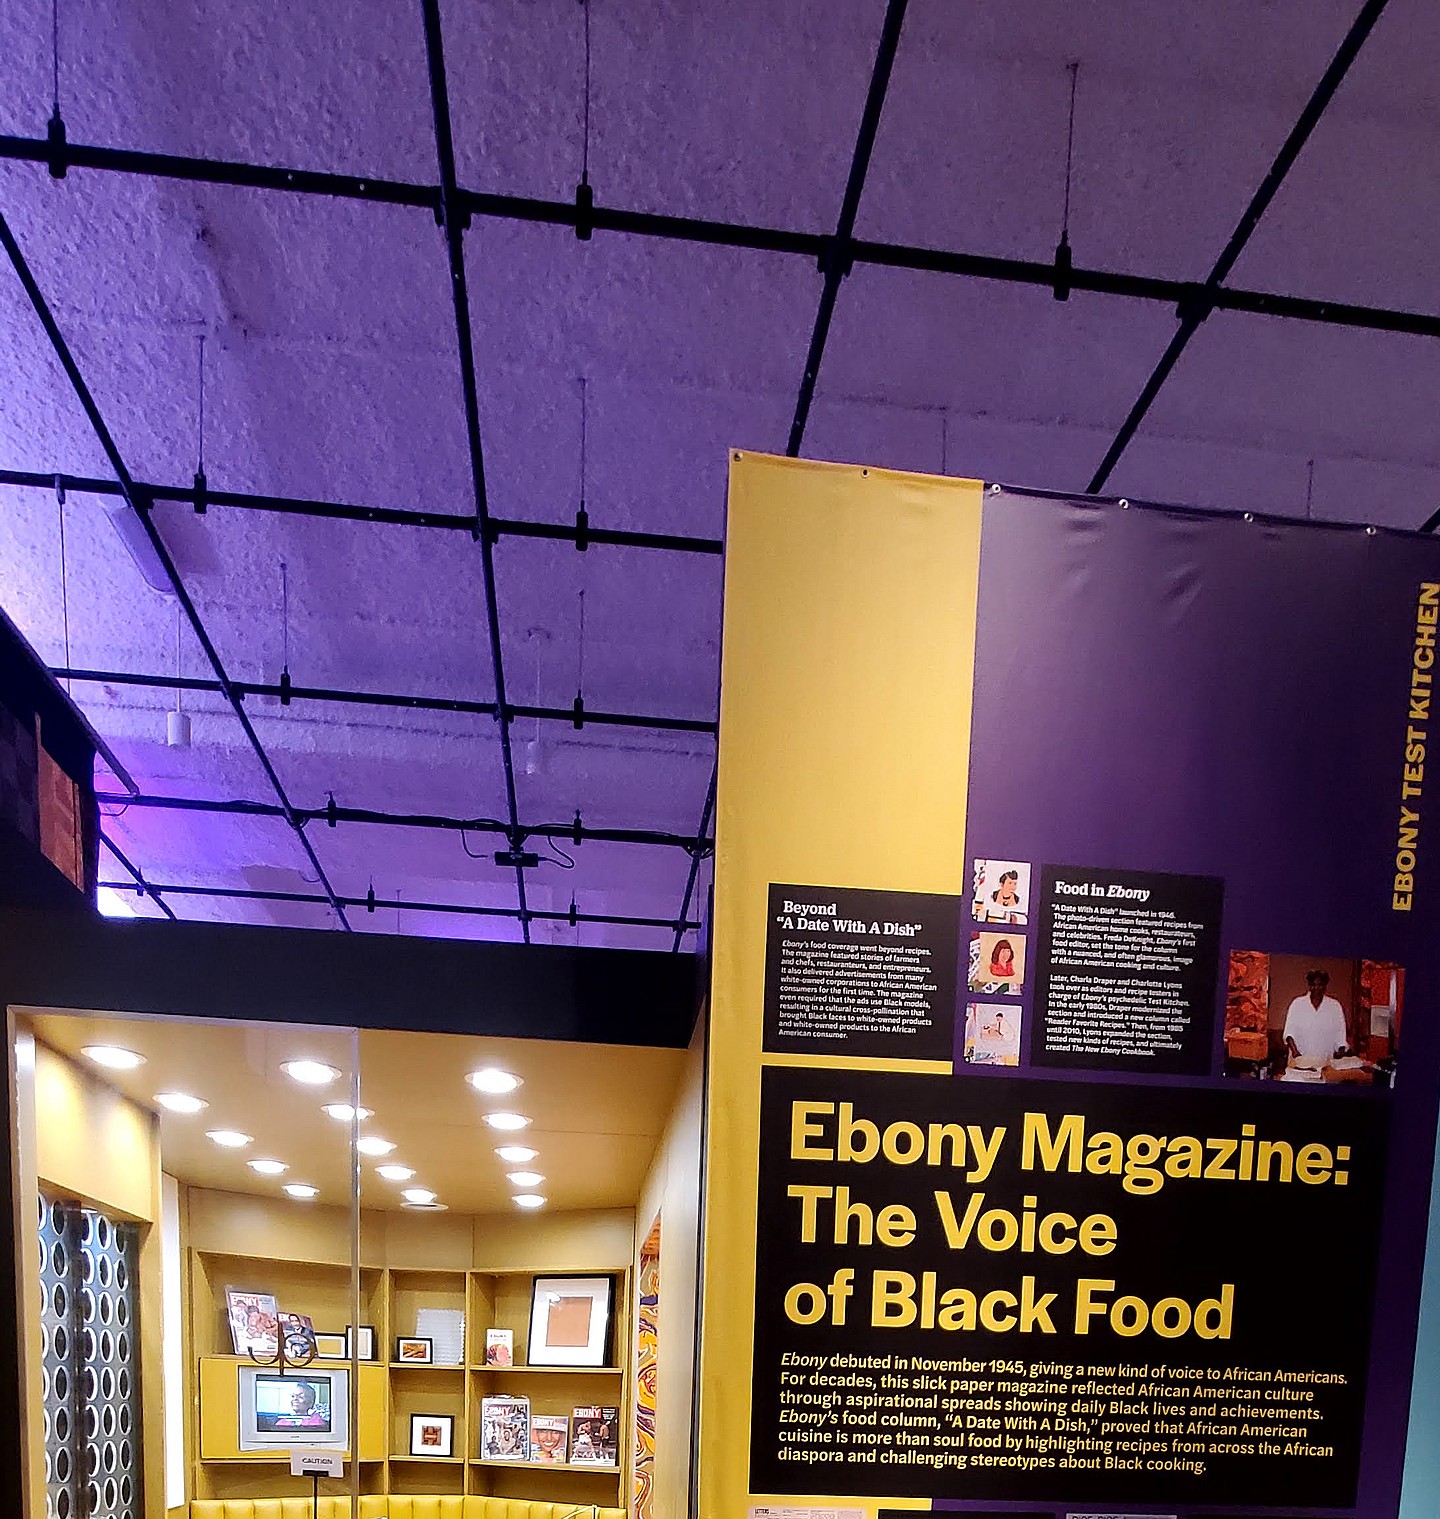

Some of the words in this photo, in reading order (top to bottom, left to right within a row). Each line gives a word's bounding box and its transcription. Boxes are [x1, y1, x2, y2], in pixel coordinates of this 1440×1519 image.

[1408, 582, 1440, 720] KITCHEN
[1402, 725, 1427, 800] TEST
[1392, 806, 1420, 911] EBONY
[1054, 881, 1089, 896] Food
[1090, 883, 1105, 897] in
[1105, 884, 1150, 902] Ebony
[782, 900, 837, 917] Beyond
[776, 916, 794, 929] "A
[796, 917, 830, 931] Date
[831, 919, 867, 933] With
[868, 921, 881, 934] A
[882, 922, 922, 937] Dish"
[790, 1100, 1007, 1183] Ebony
[1021, 1111, 1351, 1195] Magazine:
[787, 1184, 917, 1247] The
[934, 1190, 1118, 1256] Voice
[783, 1268, 855, 1326] of
[871, 1269, 1058, 1334] Black
[1074, 1278, 1235, 1339] Food
[780, 1351, 828, 1370] Ebony
[829, 1352, 891, 1369] debuted
[894, 1355, 908, 1370] in
[911, 1356, 987, 1372] November
[988, 1359, 1027, 1377] 1945,
[1029, 1360, 1074, 1380] giving
[1075, 1365, 1084, 1376] a
[1087, 1365, 1116, 1377] new
[1118, 1363, 1148, 1378] kind
[1150, 1364, 1167, 1378] of
[1167, 1365, 1204, 1379] voice
[1206, 1367, 1221, 1380] to
[1222, 1366, 1271, 1381] African
[1273, 1369, 1347, 1384] Americans.
[780, 1371, 806, 1385] For
[809, 1371, 876, 1391] decades,
[880, 1373, 909, 1389] this
[912, 1374, 947, 1390] slick
[950, 1379, 995, 1395] paper
[997, 1379, 1068, 1397] magazine
[1071, 1380, 1135, 1396] reflected
[1137, 1382, 1190, 1397] African
[1192, 1385, 1261, 1399] American
[1264, 1386, 1314, 1401] culture
[779, 1389, 841, 1409] through
[845, 1392, 938, 1410] aspirational
[941, 1395, 1001, 1413] spreads
[1004, 1396, 1068, 1416] showing
[1071, 1398, 1106, 1417] daily
[1109, 1400, 1149, 1415] Black
[1153, 1401, 1186, 1416] lives
[1189, 1403, 1216, 1416] and
[1220, 1403, 1323, 1420] achievements.
[779, 1408, 839, 1427] Ebony's
[841, 1409, 877, 1425] food
[880, 1411, 941, 1430] column,
[945, 1413, 963, 1428] "A
[966, 1415, 1001, 1429] Date
[1003, 1415, 1037, 1430] With
[1039, 1417, 1051, 1431] A
[1054, 1417, 1098, 1435] Dish,"
[1101, 1419, 1150, 1435] proved
[1154, 1420, 1184, 1434] that
[1186, 1420, 1237, 1435] African
[1239, 1423, 1307, 1438] American
[778, 1428, 832, 1443] cuisine
[836, 1429, 848, 1443] is
[852, 1433, 892, 1445] more
[895, 1430, 930, 1446] than
[933, 1432, 964, 1447] soul
[967, 1432, 1002, 1448] food
[1005, 1433, 1023, 1452] by
[1025, 1434, 1113, 1455] highlighting
[1116, 1438, 1168, 1455] recipes
[1171, 1438, 1205, 1453] from
[1208, 1443, 1254, 1454] across
[1258, 1441, 1281, 1455] the
[1283, 1441, 1333, 1456] African
[777, 1446, 844, 1465] diaspora
[847, 1448, 876, 1463] and
[879, 1449, 968, 1470] challenging
[970, 1453, 1056, 1471] stereotypes
[1058, 1454, 1101, 1469] about
[1104, 1455, 1143, 1470] Black
[1146, 1457, 1206, 1475] cooking.
